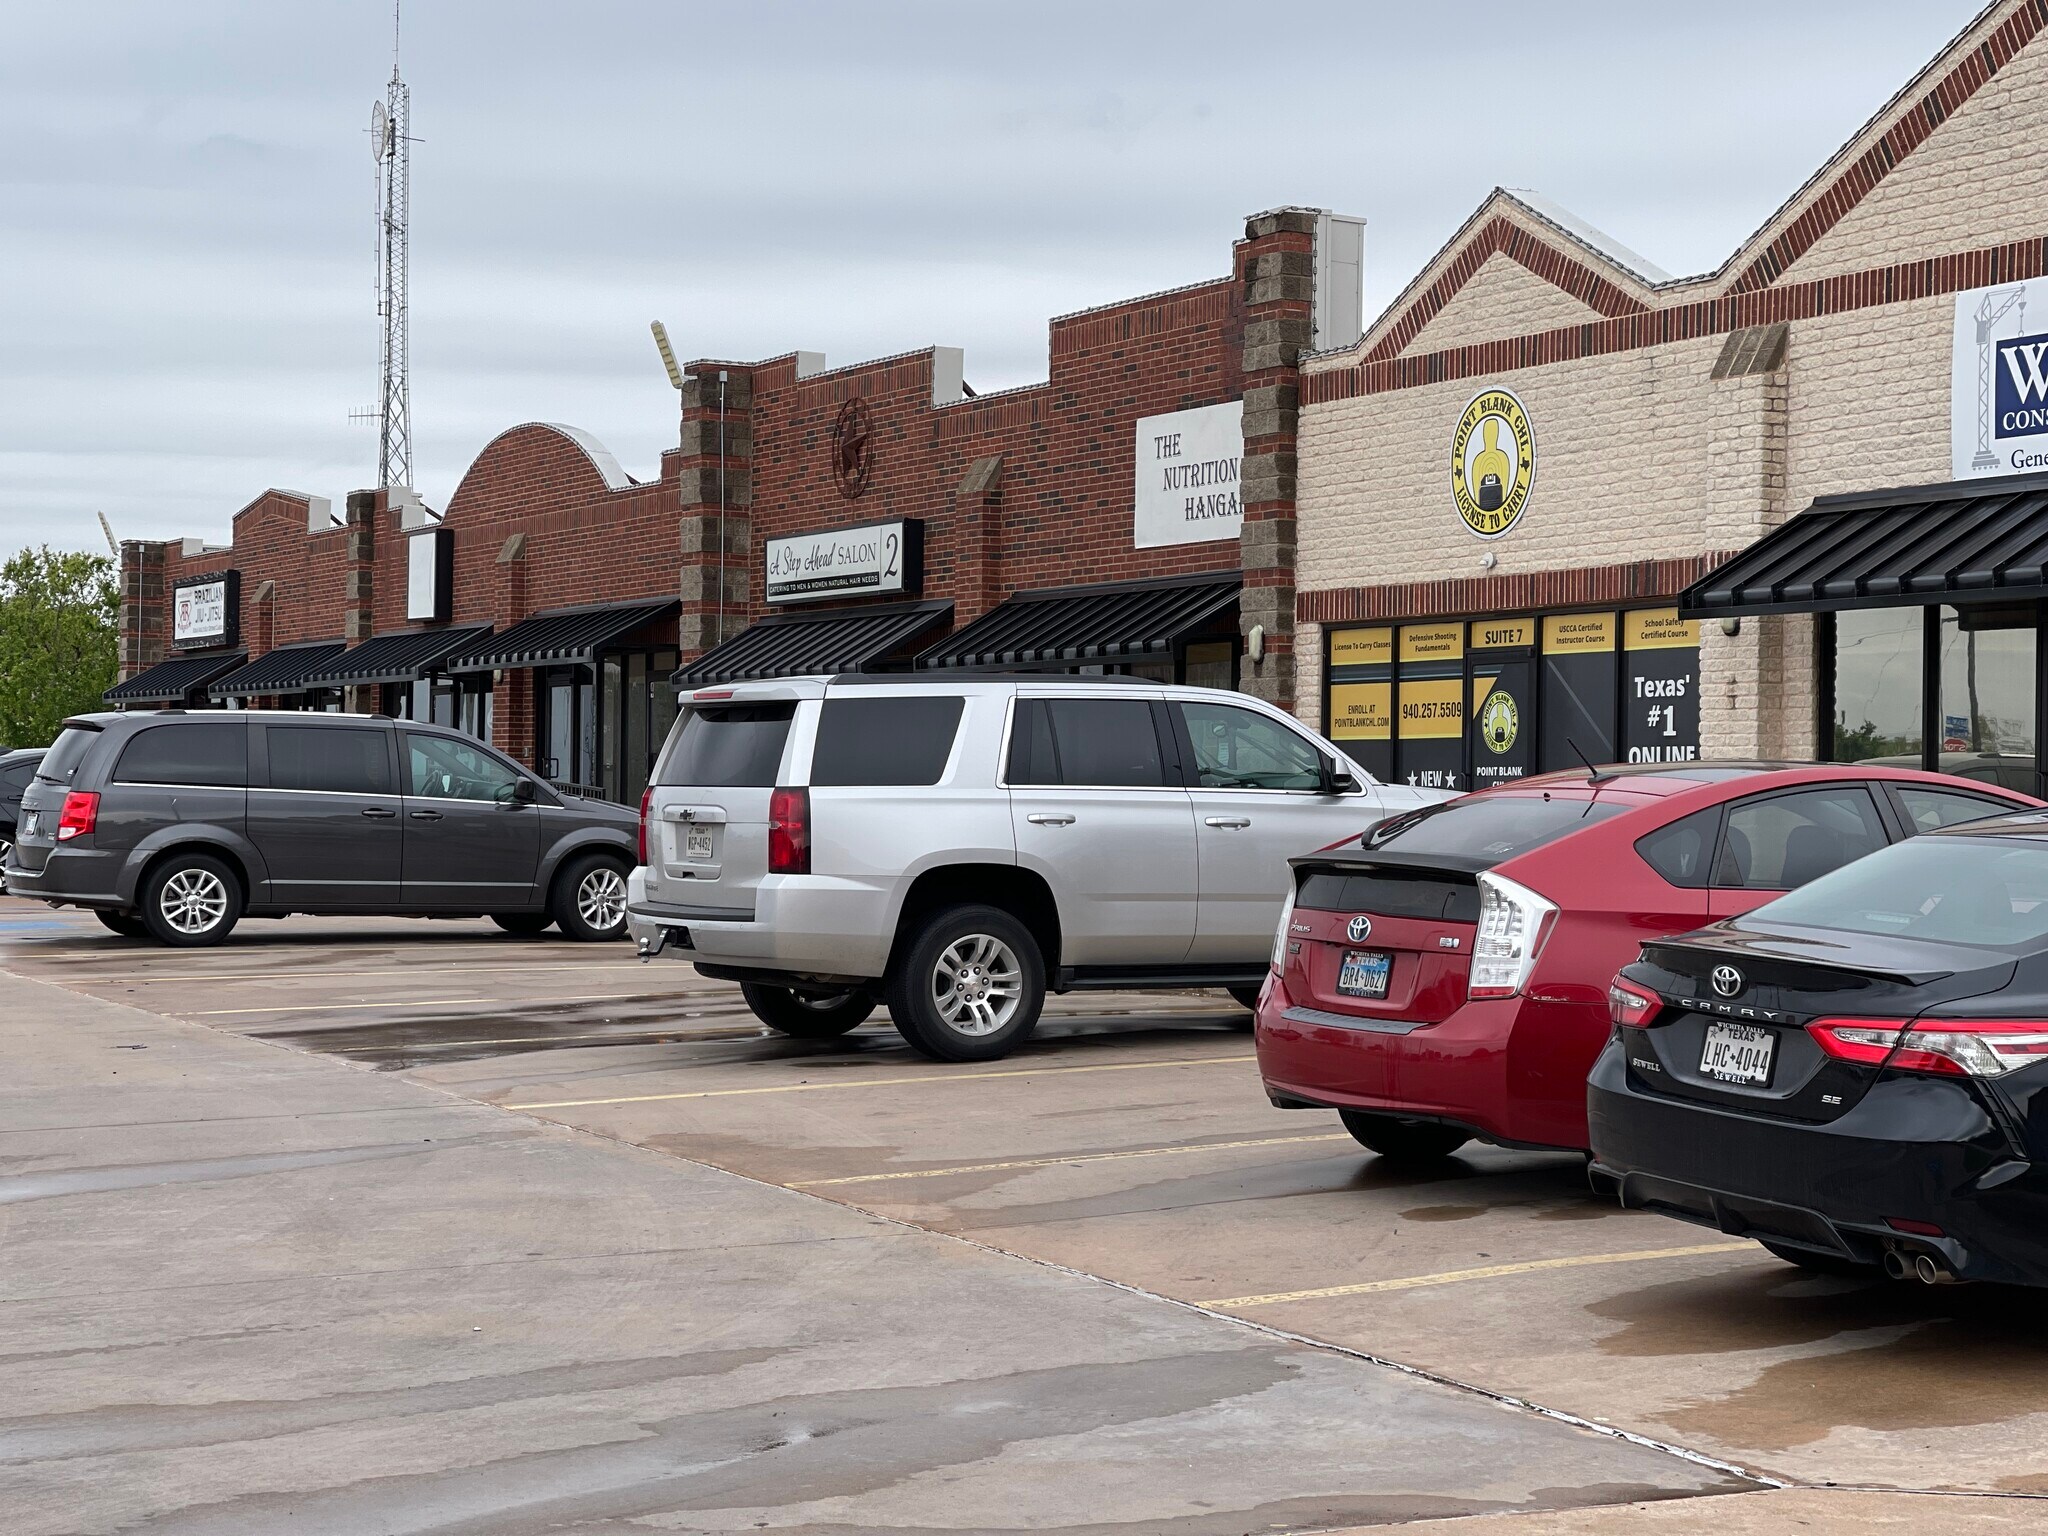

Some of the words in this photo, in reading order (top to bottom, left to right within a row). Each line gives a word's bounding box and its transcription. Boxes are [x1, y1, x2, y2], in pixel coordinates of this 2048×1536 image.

[2003, 408, 2048, 431] CON
[1455, 407, 1476, 459] POINT
[1480, 396, 1515, 417] BLANK
[1514, 415, 1529, 452] CHL
[1154, 433, 1181, 460] THE
[1163, 457, 1238, 492] NUTRITION
[1456, 485, 1486, 530] LICENSE
[1489, 512, 1500, 530] TO
[1503, 480, 1527, 522] CARRY
[770, 549, 780, 576] A
[782, 545, 801, 578] Step
[804, 542, 836, 572] Ahead
[838, 542, 877, 566] SALON
[883, 532, 899, 579] 2
[769, 584, 789, 593] CATERING
[812, 581, 828, 589] WOMEN
[828, 578, 849, 587] NATURAL
[849, 576, 861, 584] HAIR
[862, 575, 878, 583] NEEDS
[1559, 624, 1577, 633] USCCA
[1578, 622, 1603, 632] Certified
[1645, 619, 1664, 628] School
[1665, 617, 1685, 627] Safety
[1409, 634, 1433, 642] Defensive
[1434, 632, 1456, 641] Shooting
[1485, 629, 1514, 644] SUITE
[1516, 628, 1523, 642] 7
[1556, 635, 1585, 645] Instructor
[1586, 634, 1605, 643] Course
[1640, 630, 1666, 640] Certified
[1667, 629, 1689, 638] Course
[1334, 642, 1352, 651] License
[1353, 642, 1359, 650] To
[1359, 641, 1373, 650] Carry
[1373, 641, 1391, 649] Classes
[1415, 643, 1450, 653] Fundamentals
[1348, 704, 1368, 714] ENROLL
[1369, 704, 1376, 714] AT
[1402, 701, 1462, 719] 940.257.5509
[1485, 699, 1495, 719] POINT
[1335, 717, 1390, 728] POINTBLANKCHL.COM
[1647, 704, 1677, 736] #1
[1420, 770, 1443, 787] NEW
[1476, 766, 1498, 777] POINT
[1498, 766, 1523, 777] BLANK
[1291, 921, 1311, 933] PRIUS
[1357, 956, 1378, 967] TEXAS
[1681, 998, 1779, 1019] CAMRY
[1716, 1021, 1744, 1031] WICHITA
[1746, 1025, 1765, 1035] FALLS
[1728, 1029, 1755, 1042] TEXAS
[1632, 1057, 1661, 1071] SEWELL
[1703, 1040, 1731, 1068] LHC
[1735, 1046, 1769, 1075] 4044
[1714, 1070, 1746, 1085] SEWELL
[1821, 1094, 1842, 1105] SE
